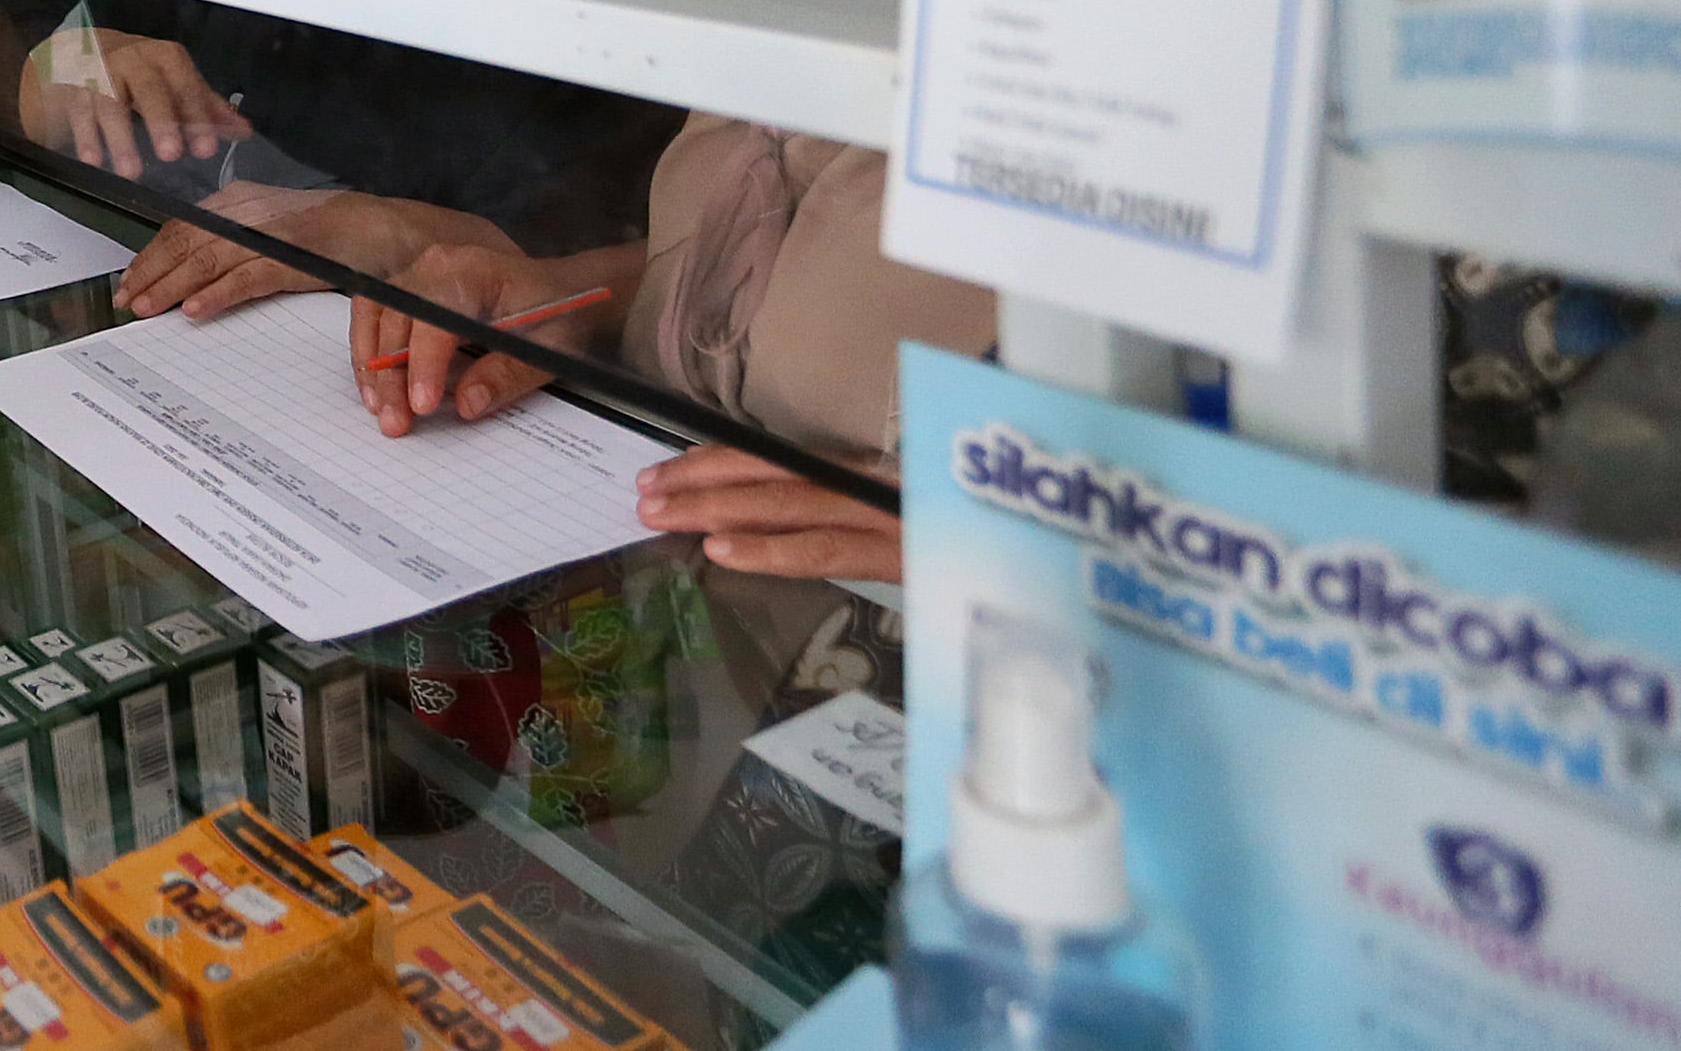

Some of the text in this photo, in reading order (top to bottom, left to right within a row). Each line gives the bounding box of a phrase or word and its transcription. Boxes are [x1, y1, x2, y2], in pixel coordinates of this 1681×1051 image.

[955, 152, 1102, 220] TERSEDIA
[960, 434, 1672, 731] silahkan dicoba
[1090, 556, 1607, 788] bisa beli di sini
[268, 750, 303, 784] KAPAK
[273, 743, 295, 762] CAP
[158, 876, 248, 941] GPU
